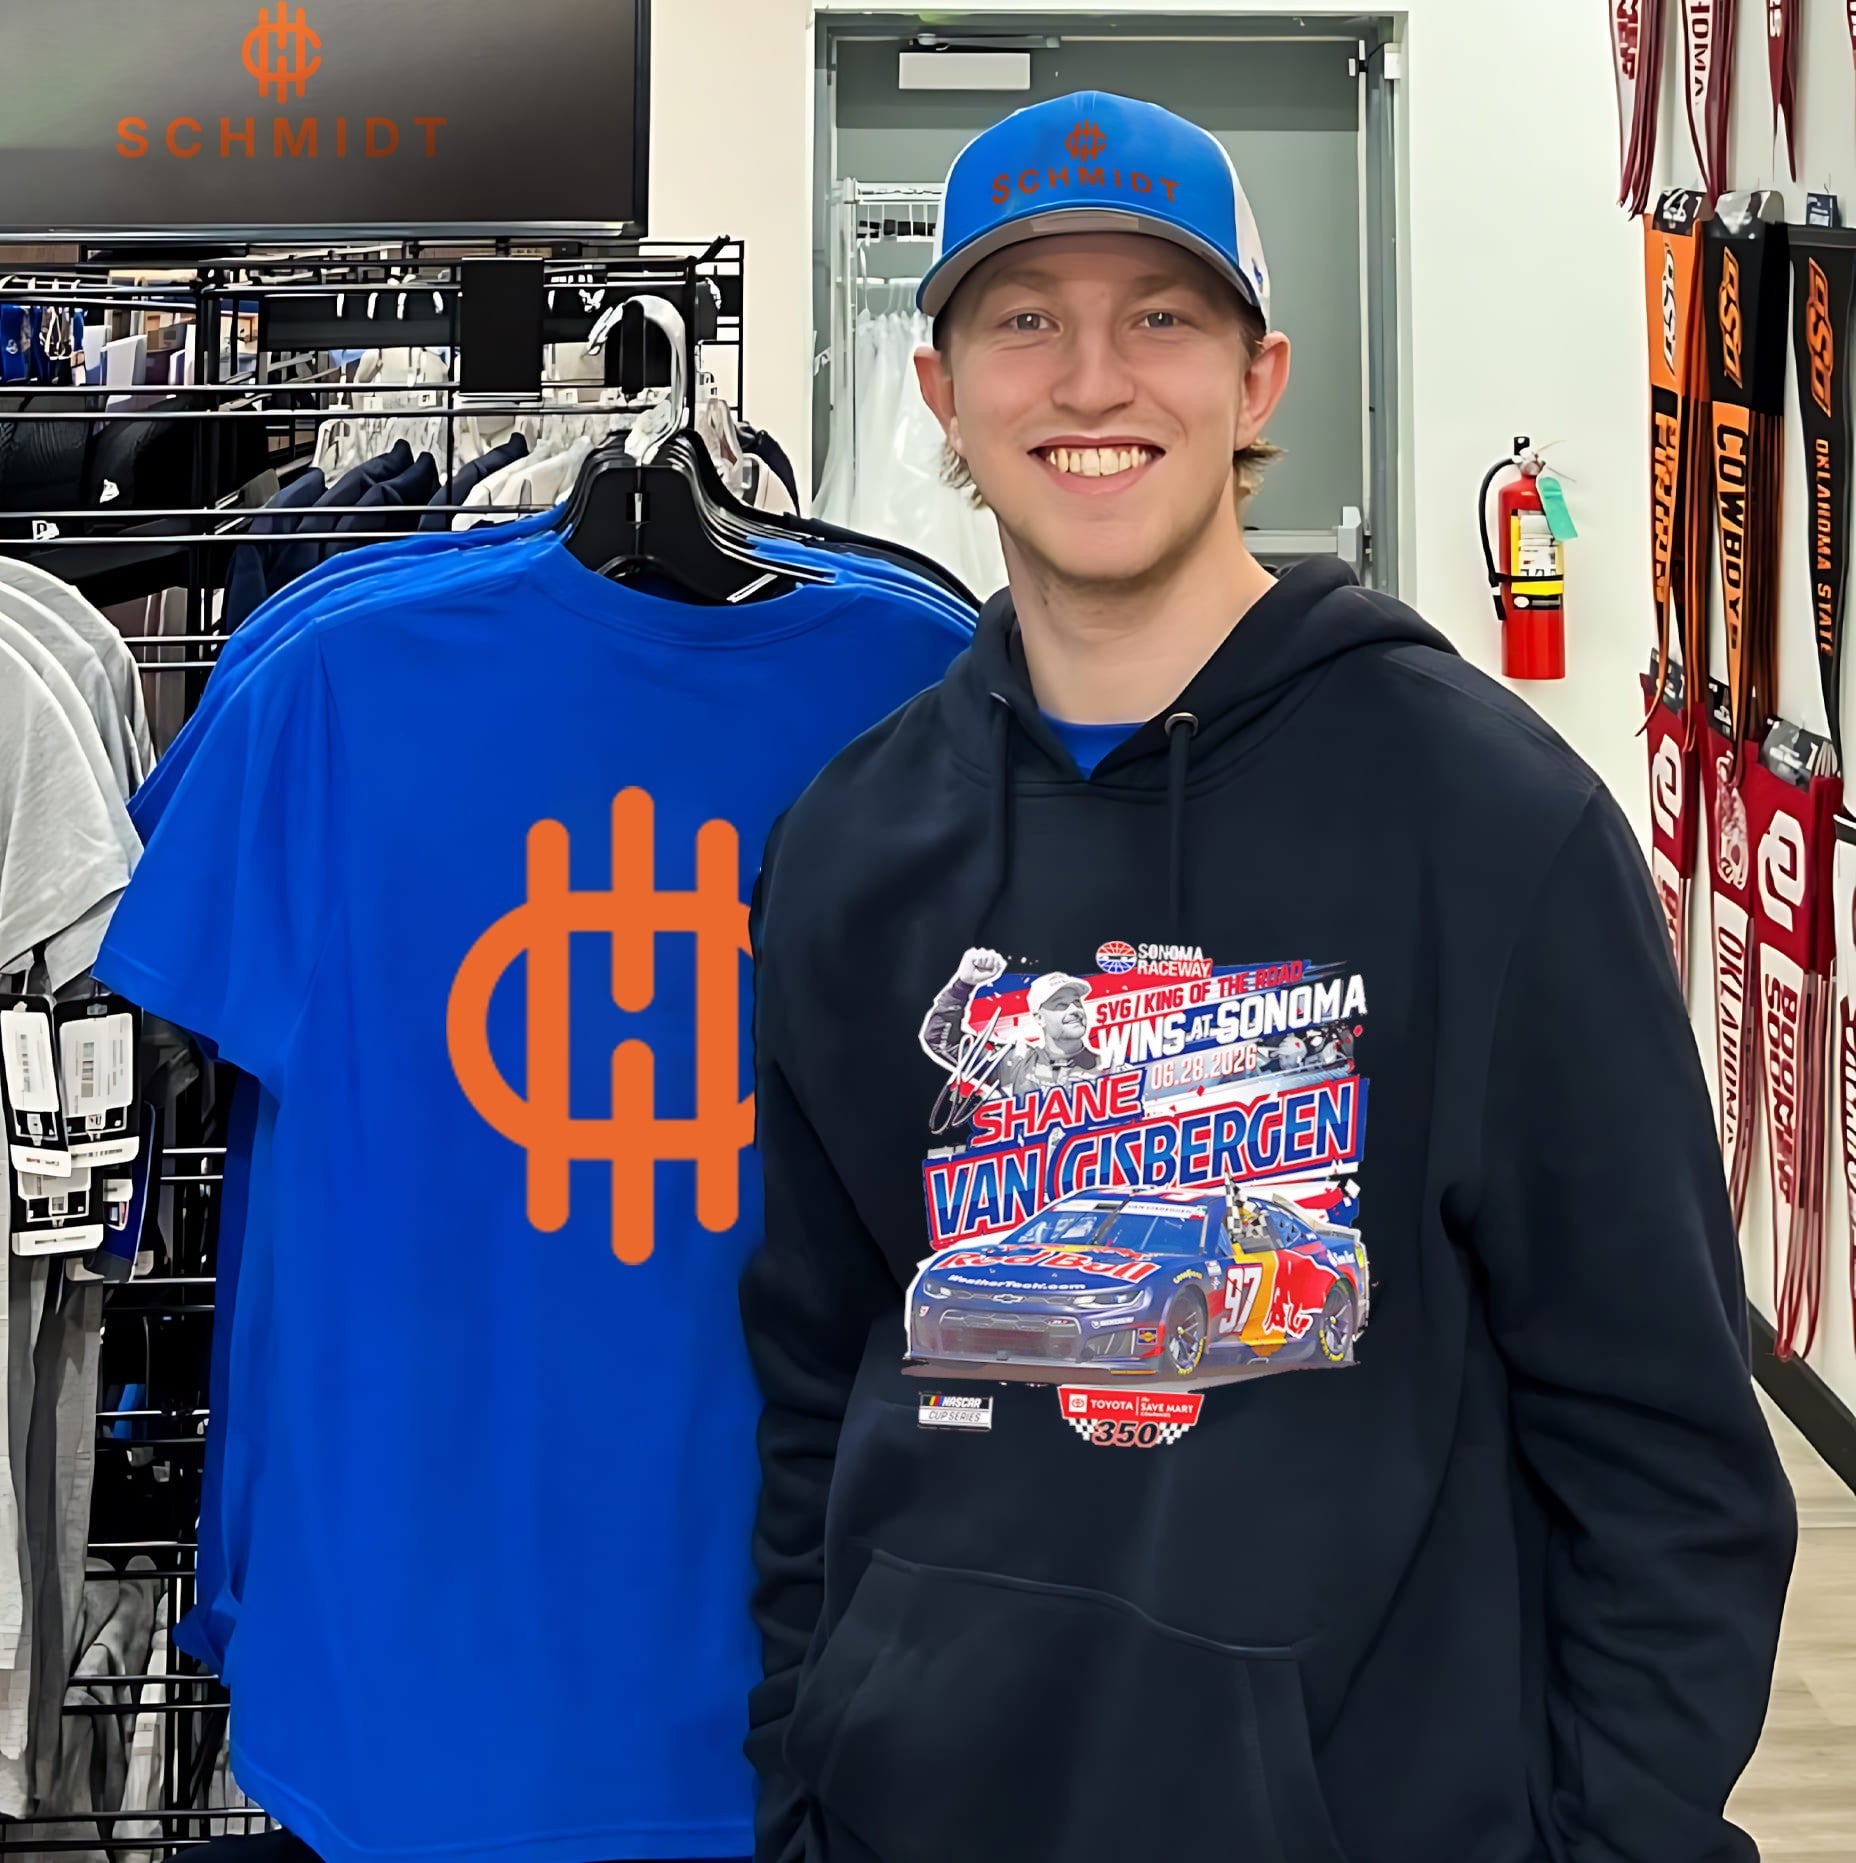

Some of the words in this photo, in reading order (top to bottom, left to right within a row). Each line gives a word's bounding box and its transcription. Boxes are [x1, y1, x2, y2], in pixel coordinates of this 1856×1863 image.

[115, 116, 448, 159] SCHMIDT
[991, 167, 1180, 205] SCHMIDT
[1137, 959, 1211, 978] RACEWAY
[1138, 943, 1203, 961] SONOMA
[1096, 1000, 1132, 1024] SVG
[1144, 988, 1184, 1014] KING
[1190, 981, 1212, 1003] OF
[1218, 973, 1251, 998] THE
[1255, 960, 1303, 990] ROAD
[1099, 1012, 1187, 1071] WINS
[1189, 1012, 1214, 1041] AT
[1216, 974, 1368, 1045] SONOMA
[1718, 926, 1743, 1144] OKLAHOMA
[1151, 1044, 1258, 1090] 06.28.2026
[971, 1071, 1142, 1147] SHANE
[928, 1150, 1040, 1239] VAN
[1055, 1081, 1356, 1197] GISBERGEN
[930, 1249, 1056, 1271] Red
[1038, 1251, 1162, 1284] Bull
[1218, 1262, 1264, 1335] 97
[928, 1410, 949, 1420] CUP
[949, 1411, 981, 1422] SERIES
[942, 1396, 982, 1408] NASCAR
[1090, 1399, 1133, 1410] TOYOTA
[1140, 1402, 1165, 1411] SAVE
[1166, 1404, 1194, 1413] MART
[1092, 1419, 1159, 1446] 350
